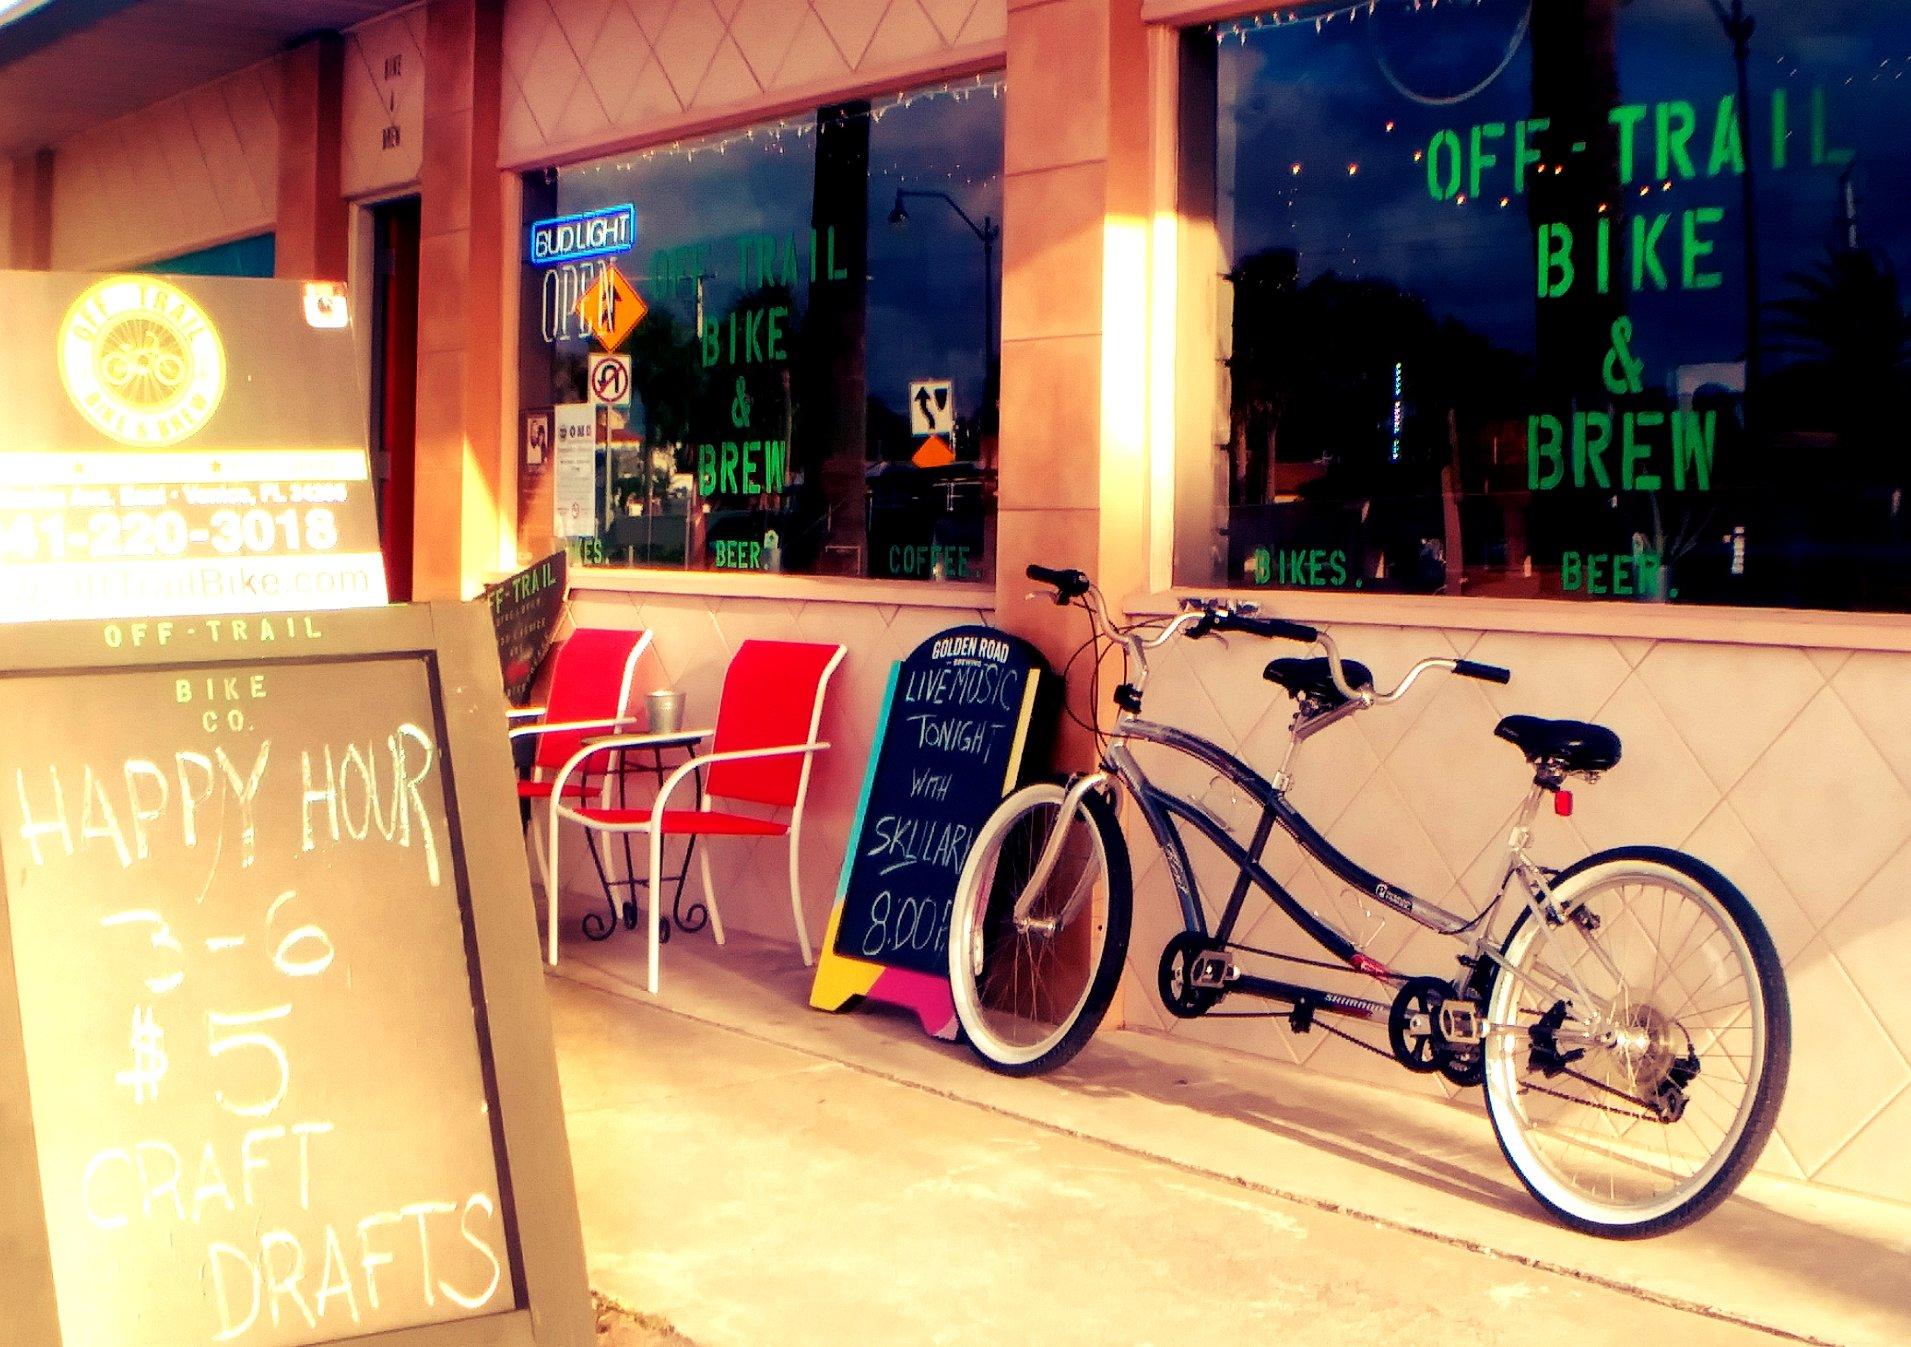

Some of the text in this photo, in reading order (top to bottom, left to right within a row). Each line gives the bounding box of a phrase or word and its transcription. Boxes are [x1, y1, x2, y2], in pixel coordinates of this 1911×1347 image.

[534, 214, 631, 257] BUD LIGHT
[1537, 208, 1725, 298] BIKE
[542, 257, 617, 343] OPEN
[702, 306, 788, 368] BIKE
[1603, 316, 1643, 395] &
[732, 376, 750, 429] &
[699, 440, 786, 496] BREW
[1527, 410, 1717, 492] BREW
[931, 636, 1010, 664] GOLDEN ROAD
[175, 674, 268, 703] BIKE
[905, 663, 1018, 711] LIVE MUSIC
[201, 708, 255, 733] CO.
[906, 713, 1007, 765] TONIGHT
[15, 722, 440, 887] HAPPY HOUR
[910, 766, 953, 801] WITH
[81, 1121, 334, 1229] CRAFT
[207, 1193, 501, 1342] DRAFTS
